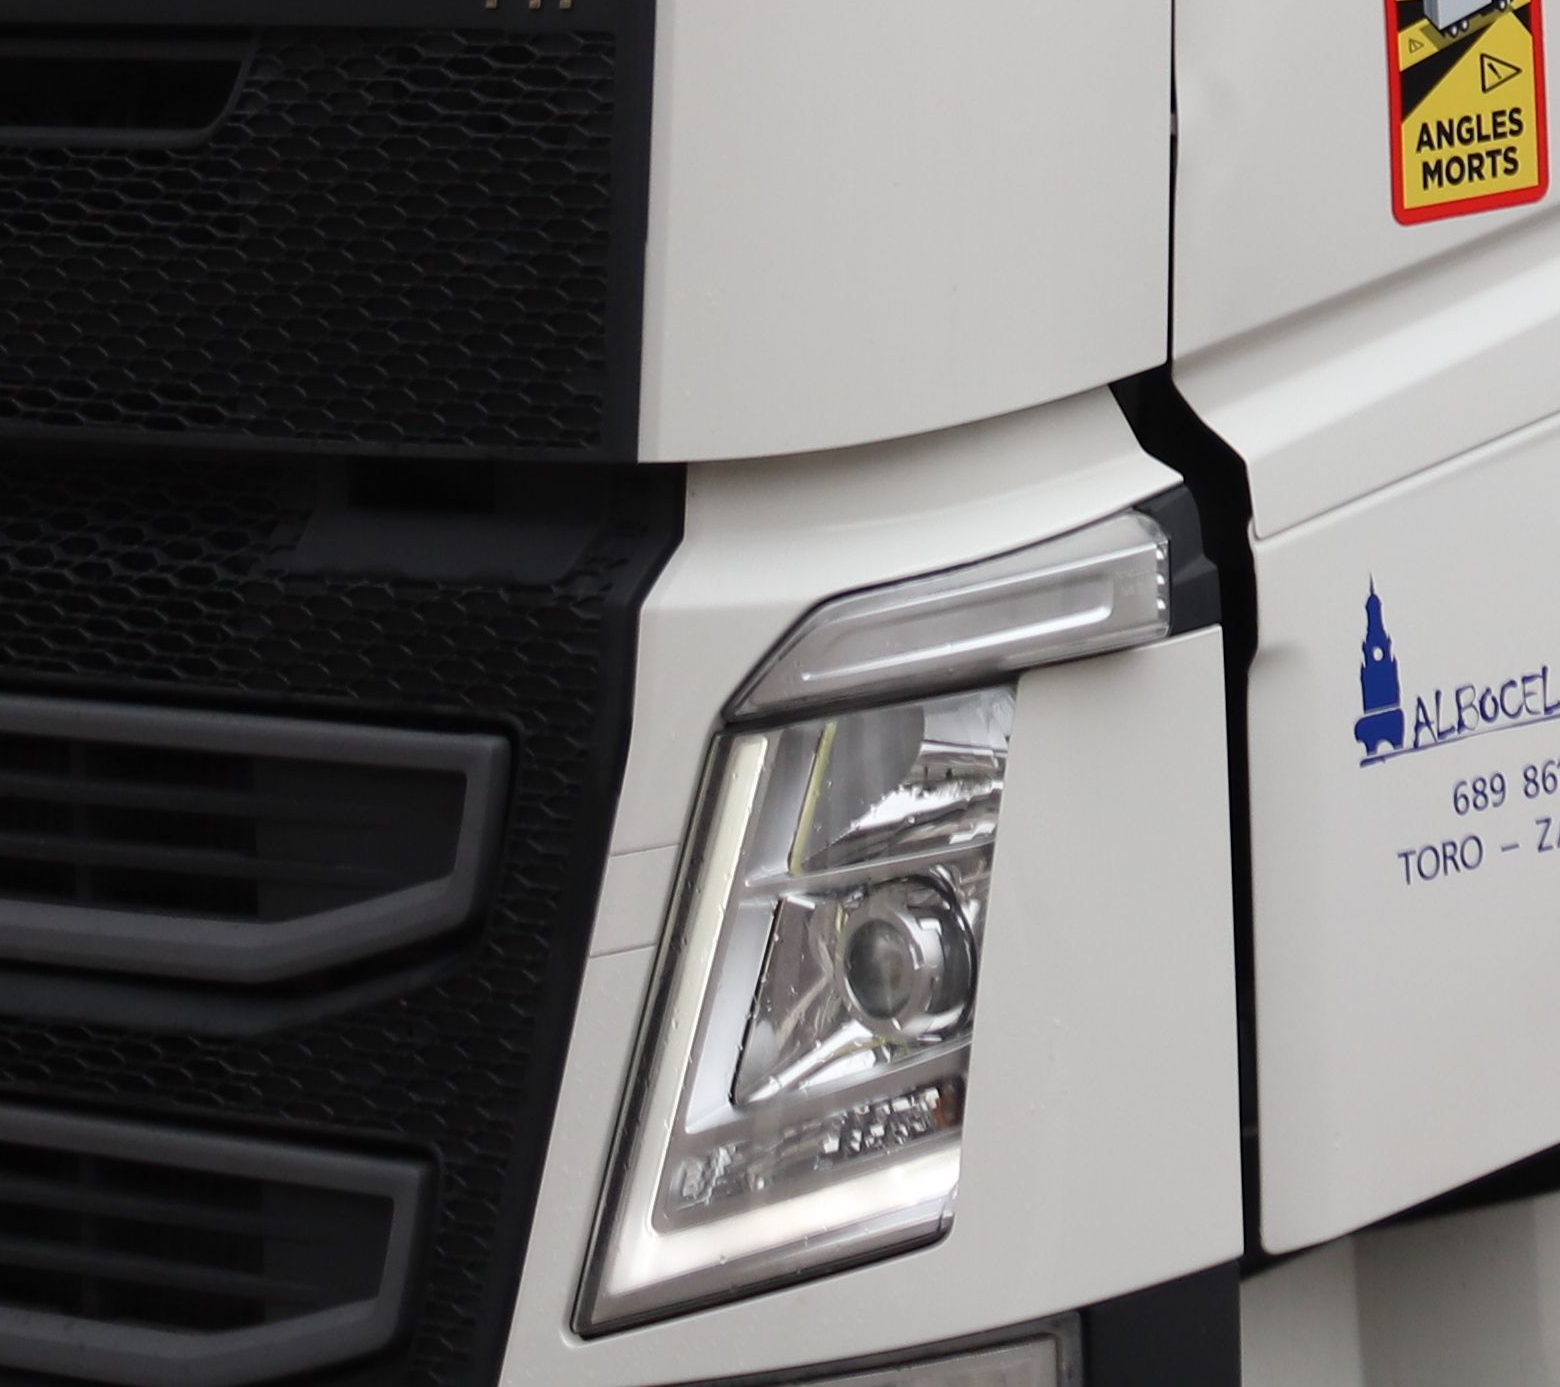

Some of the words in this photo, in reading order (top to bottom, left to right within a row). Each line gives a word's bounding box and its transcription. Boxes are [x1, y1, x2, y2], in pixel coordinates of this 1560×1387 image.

[1416, 107, 1524, 153] ANGLES
[1422, 146, 1520, 190] MORTS
[1453, 772, 1507, 816] 689
[1398, 835, 1484, 886] TORO
